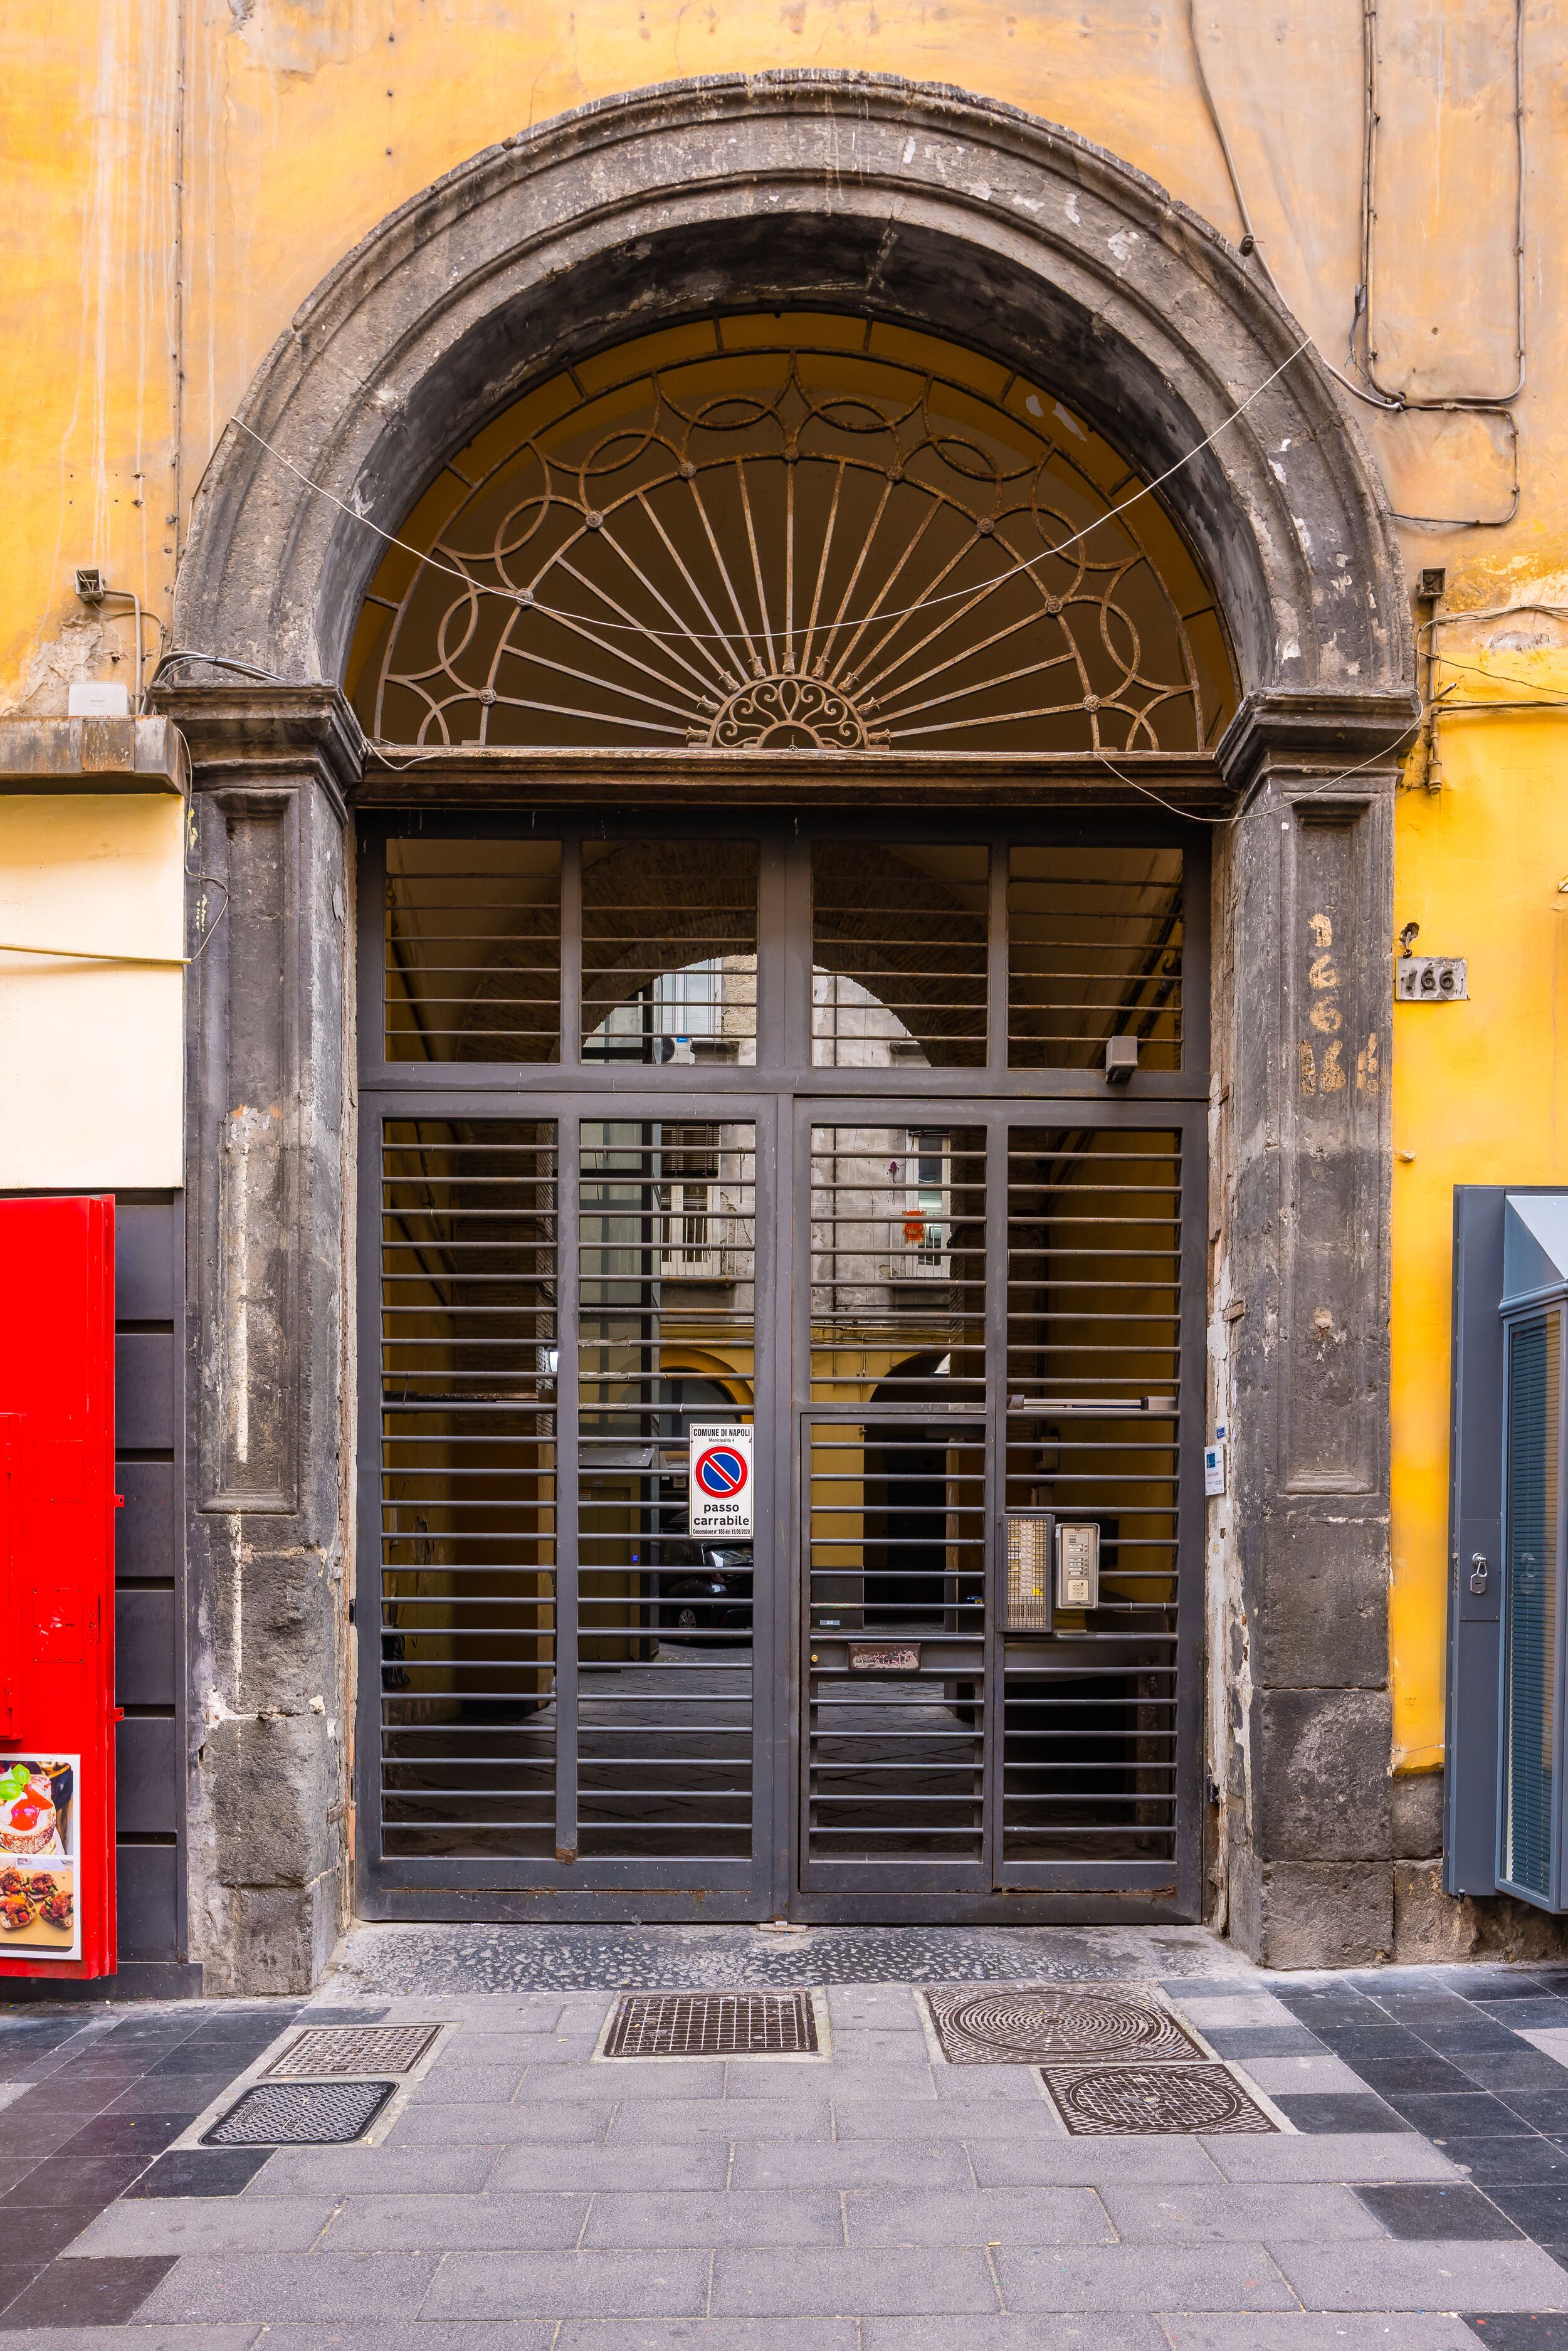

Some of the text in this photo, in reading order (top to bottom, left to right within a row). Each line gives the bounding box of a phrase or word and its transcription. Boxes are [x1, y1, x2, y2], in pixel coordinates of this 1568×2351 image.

[1406, 967, 1455, 991] 166
[693, 1428, 750, 1437] COMUNE DI NAPOLI
[703, 1504, 740, 1514] passo
[693, 1515, 750, 1526] carrabile
